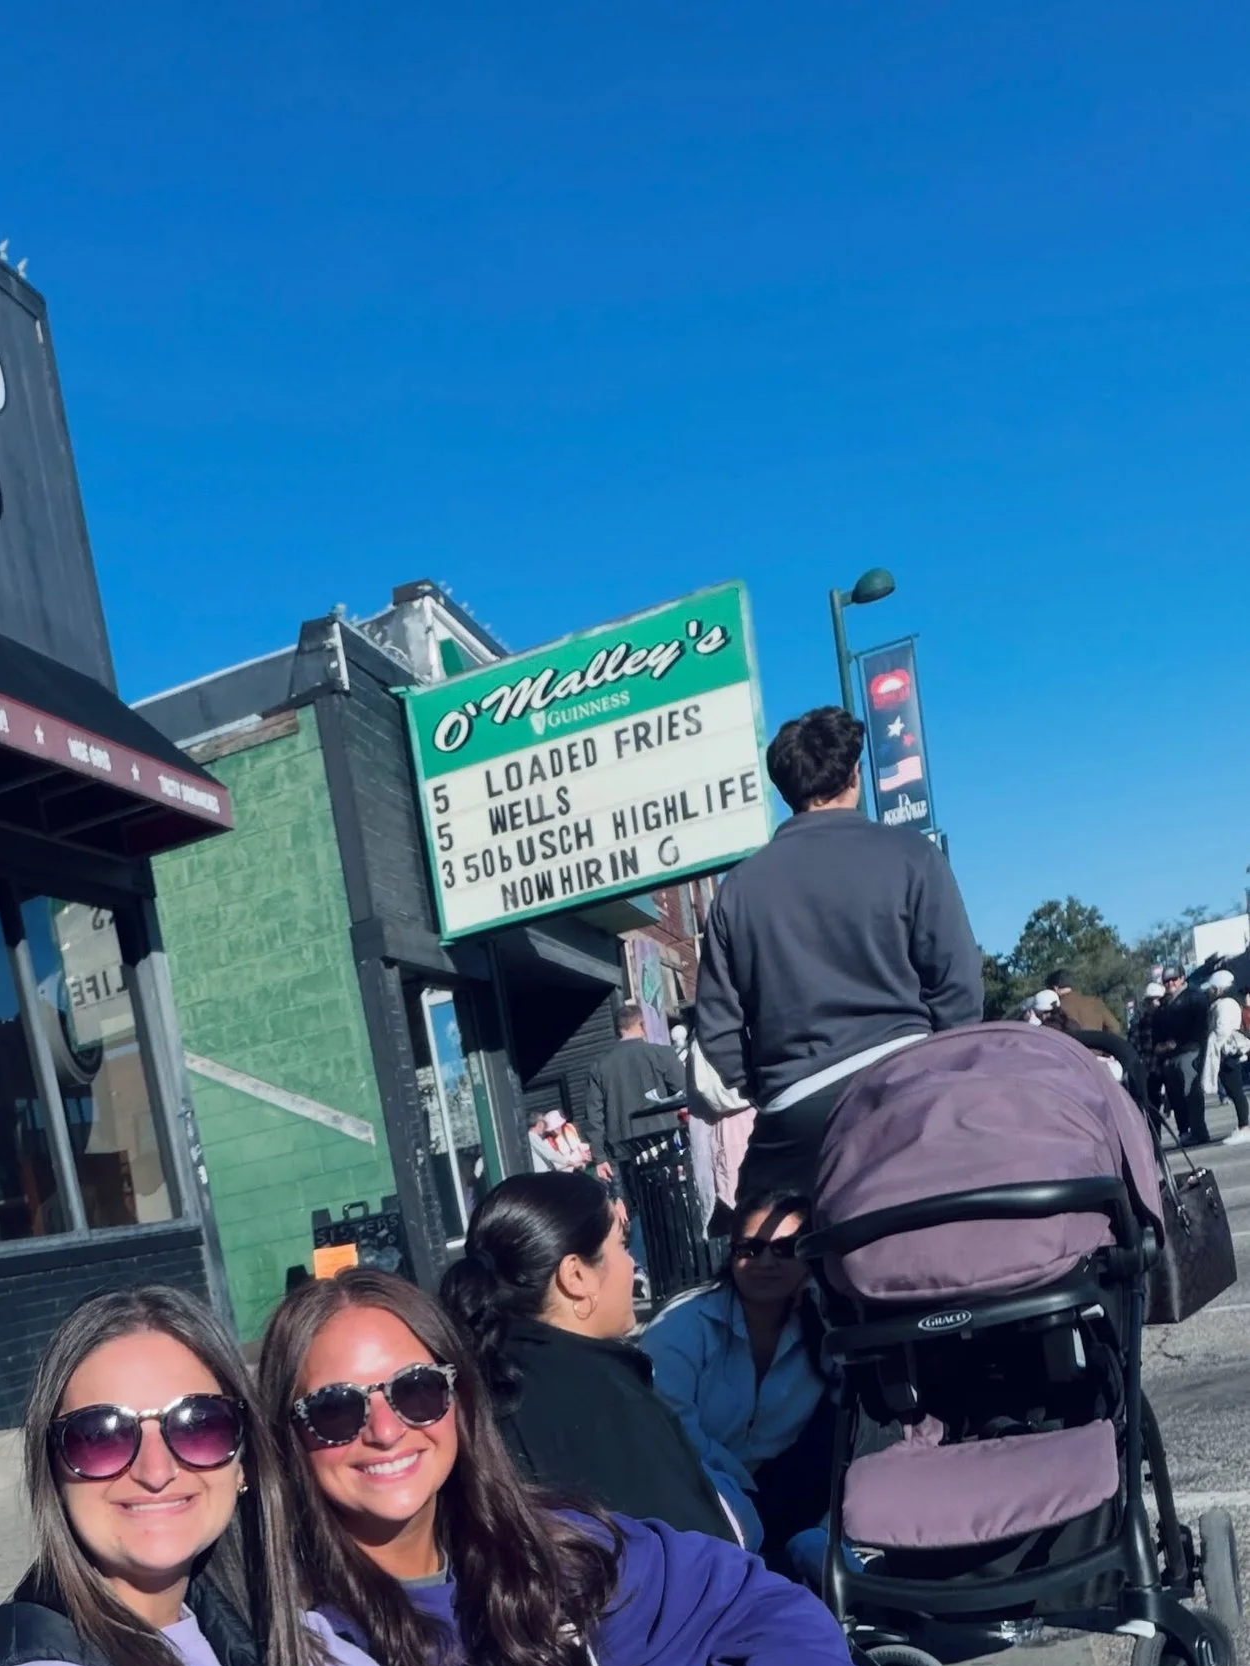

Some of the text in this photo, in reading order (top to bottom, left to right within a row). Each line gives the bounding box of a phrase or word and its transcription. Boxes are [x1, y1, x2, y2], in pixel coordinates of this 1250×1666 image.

[432, 618, 733, 755] O'Malley's
[547, 690, 631, 729] GUINNESS
[433, 704, 703, 815] 5 LOADED FRIES
[437, 786, 571, 852] 5 WELLS
[501, 870, 556, 912] NOW
[925, 1312, 968, 1328] GRACO
